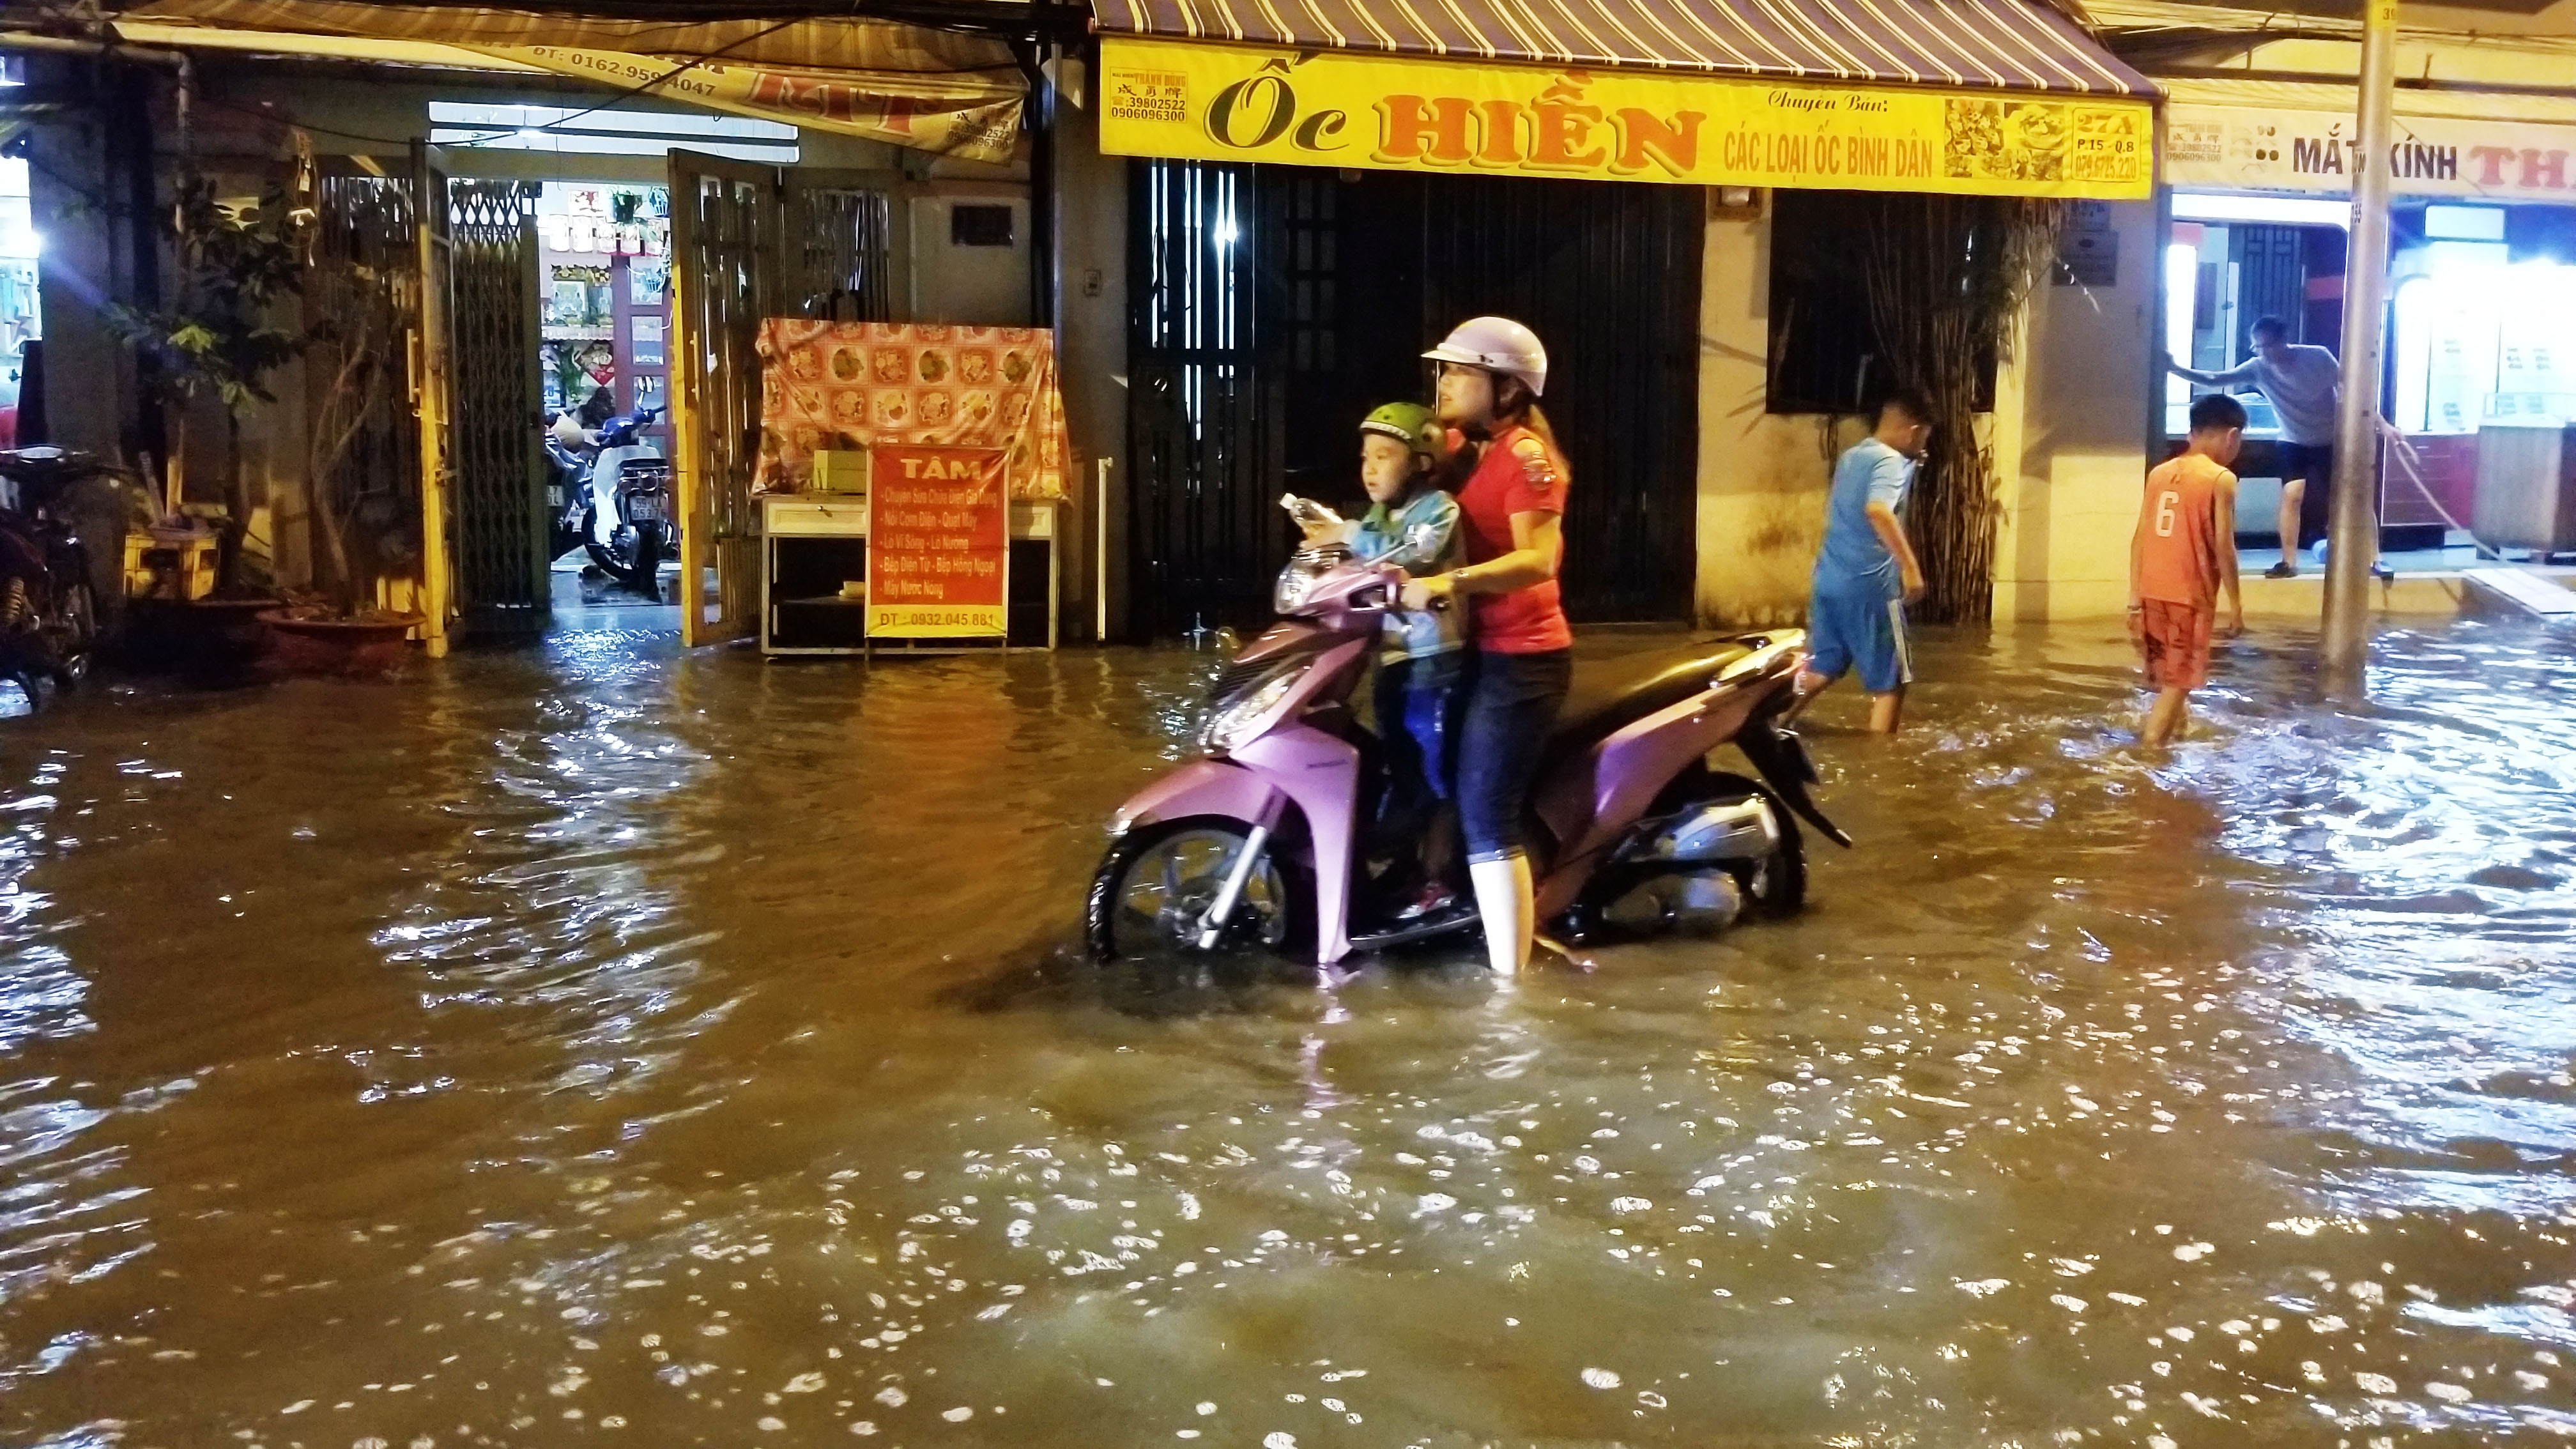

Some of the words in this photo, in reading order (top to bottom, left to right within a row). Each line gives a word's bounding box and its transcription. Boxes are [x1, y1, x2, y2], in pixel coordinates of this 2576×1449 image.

[1204, 51, 1350, 151] Ốc
[1768, 90, 1837, 112] Chuyên
[1844, 94, 1887, 112] Bán:
[1111, 107, 1185, 121] 0906096300
[2076, 114, 2135, 135] 27A
[1724, 121, 1761, 172] CÁC
[1766, 133, 1808, 183] LOẠI
[1814, 119, 1841, 175] ỐC
[1847, 125, 1889, 177] BÌNH
[1895, 128, 1933, 178] DÂN
[2077, 139, 2104, 151] P.15
[2115, 141, 2135, 154] Q.8
[2293, 123, 2358, 174] MẮ
[2466, 145, 2576, 190] TH
[900, 456, 982, 480] TÂM
[966, 489, 978, 505] Gia
[2155, 491, 2180, 537] 6
[910, 613, 994, 626] 0932.045.881
